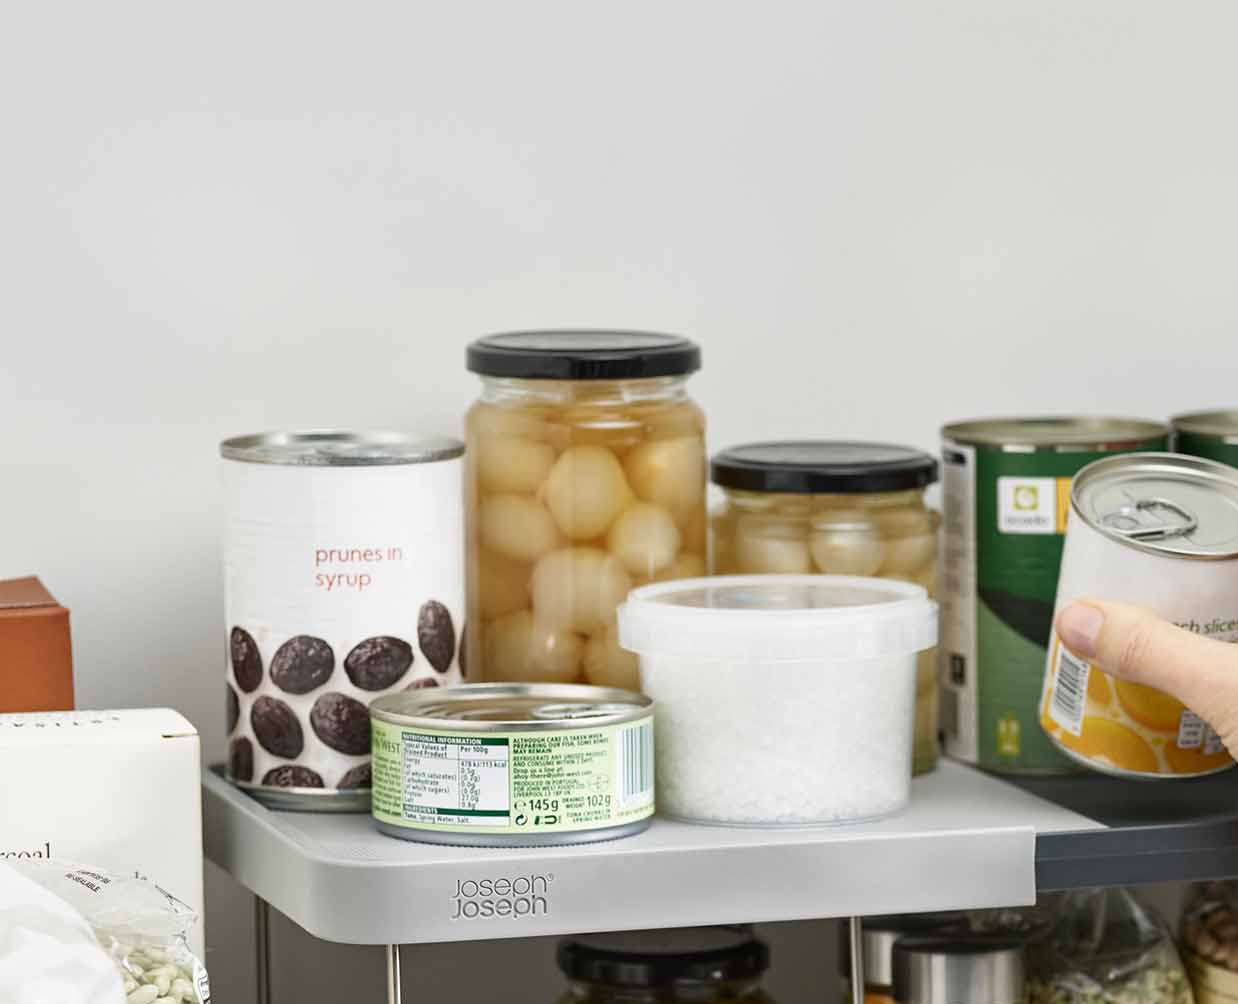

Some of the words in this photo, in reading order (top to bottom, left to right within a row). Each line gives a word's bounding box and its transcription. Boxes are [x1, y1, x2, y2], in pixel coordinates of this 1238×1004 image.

[315, 548, 384, 567] prunes
[387, 546, 403, 561] in
[314, 573, 372, 592] syrup
[438, 737, 481, 745] INFORMATION
[529, 799, 559, 812] 145g
[587, 795, 611, 807] 102g
